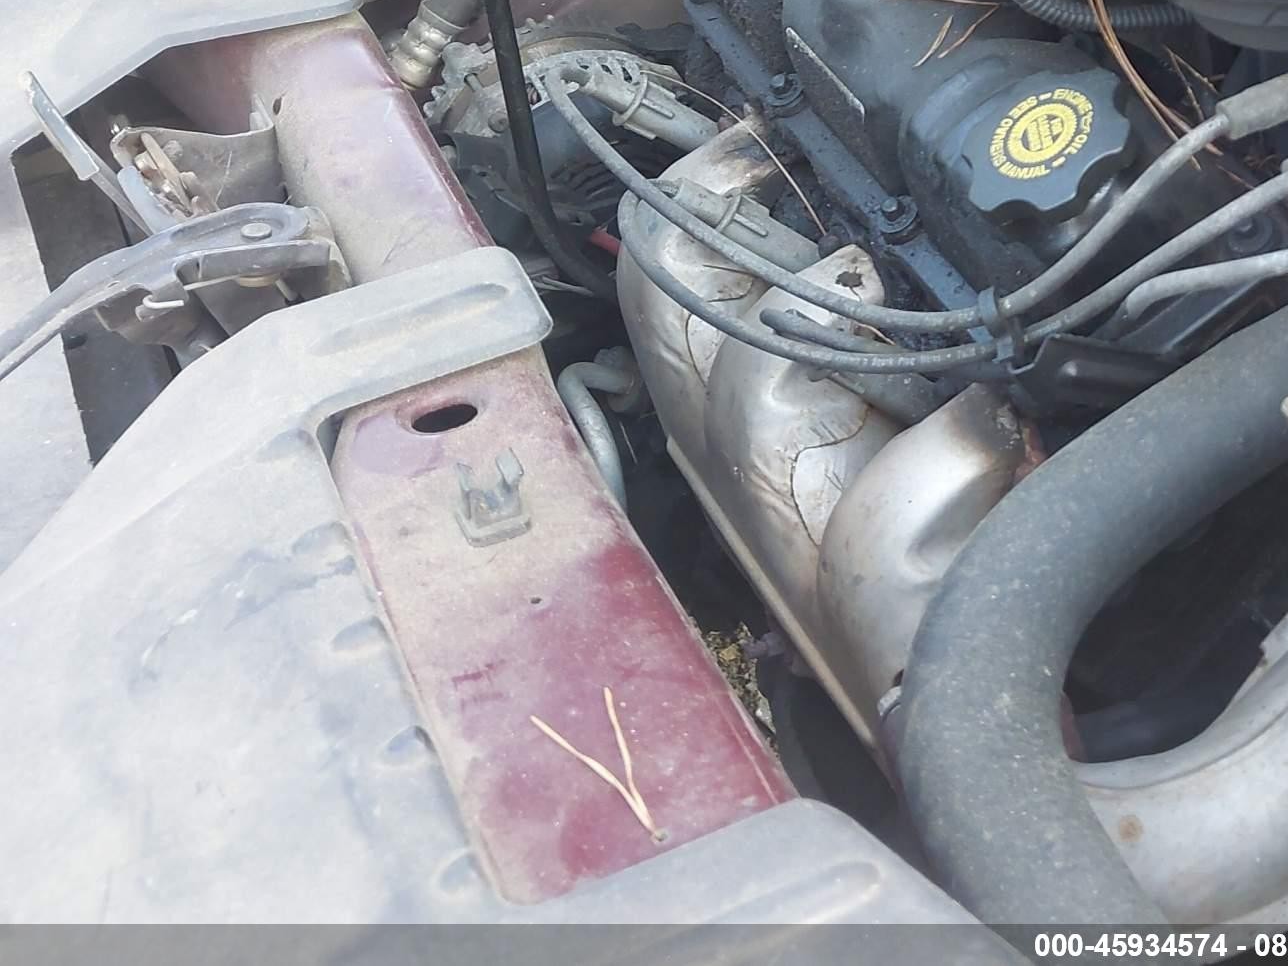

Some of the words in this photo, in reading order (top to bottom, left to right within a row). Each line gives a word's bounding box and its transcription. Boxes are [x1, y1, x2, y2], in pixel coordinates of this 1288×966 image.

[1008, 96, 1038, 119] SEE
[1053, 88, 1093, 115] ENGINE
[1063, 134, 1088, 155] OIL
[998, 161, 1051, 179] MANUAL
